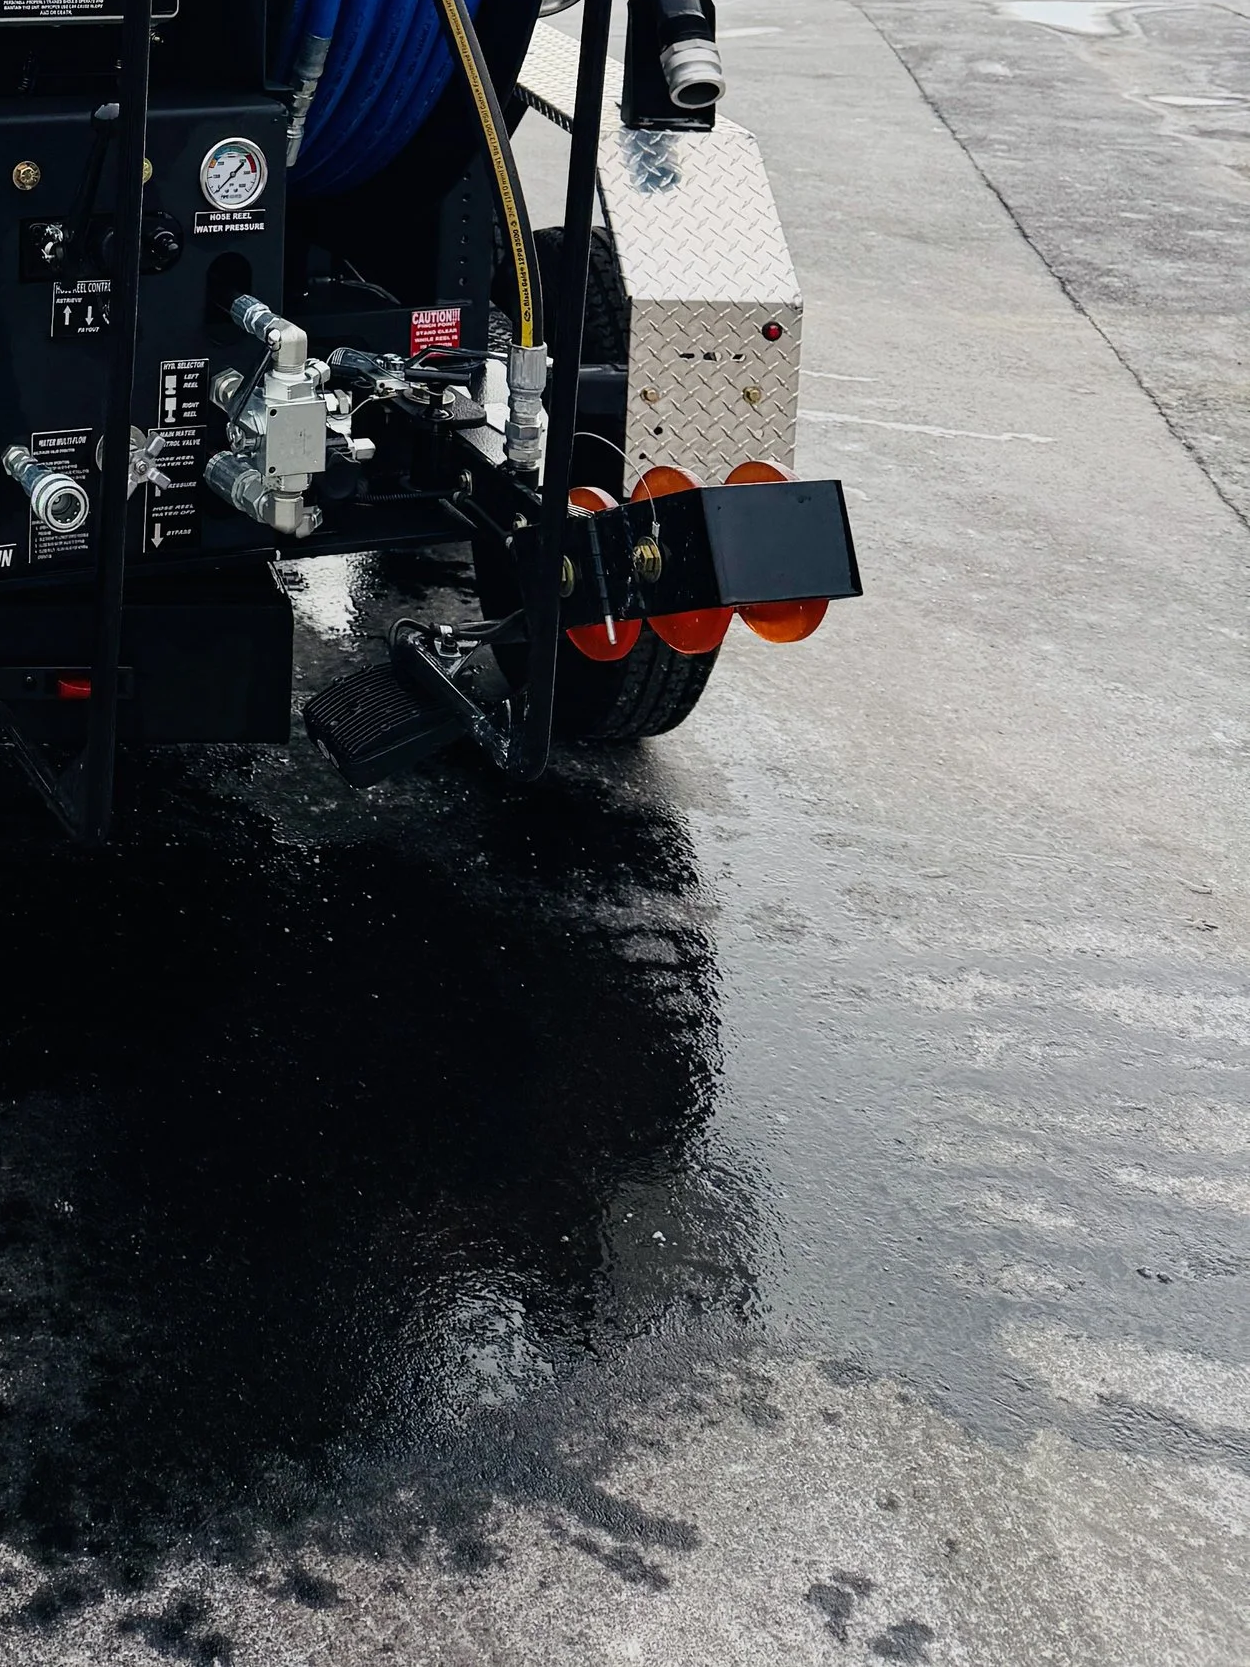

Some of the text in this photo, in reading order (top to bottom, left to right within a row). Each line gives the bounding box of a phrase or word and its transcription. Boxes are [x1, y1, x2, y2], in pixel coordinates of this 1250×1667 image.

[197, 223, 264, 233] WATER PRESSURE
[412, 310, 460, 325] CAUTION!!!
[177, 361, 205, 369] SELECTOR
